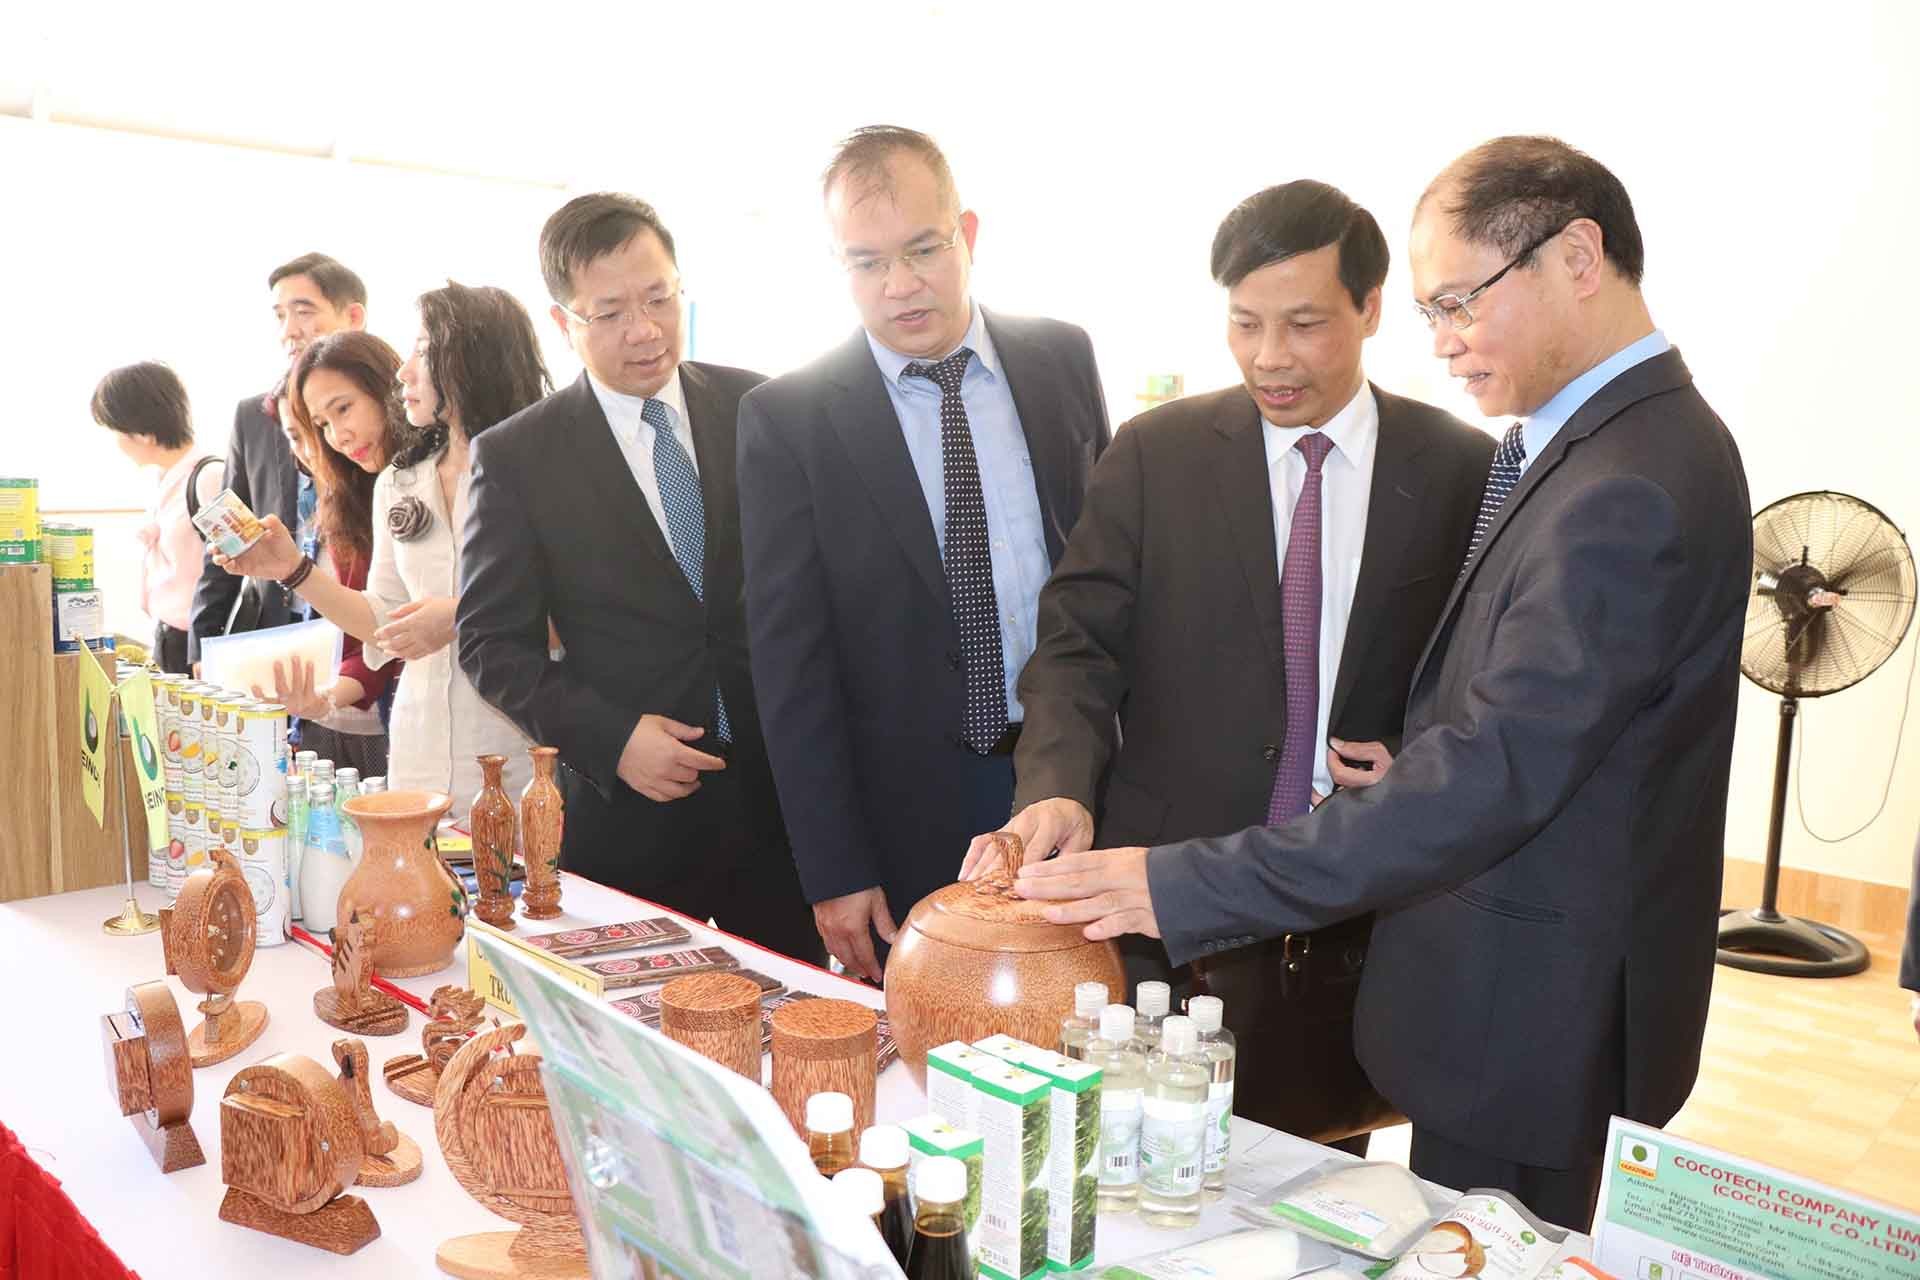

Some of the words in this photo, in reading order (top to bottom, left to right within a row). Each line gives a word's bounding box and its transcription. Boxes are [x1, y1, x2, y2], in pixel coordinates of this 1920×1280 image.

[1674, 1155, 1771, 1197] COCOTECH
[1778, 1189, 1880, 1231] COMPANY
[1713, 1183, 1823, 1228] (COCOTECH
